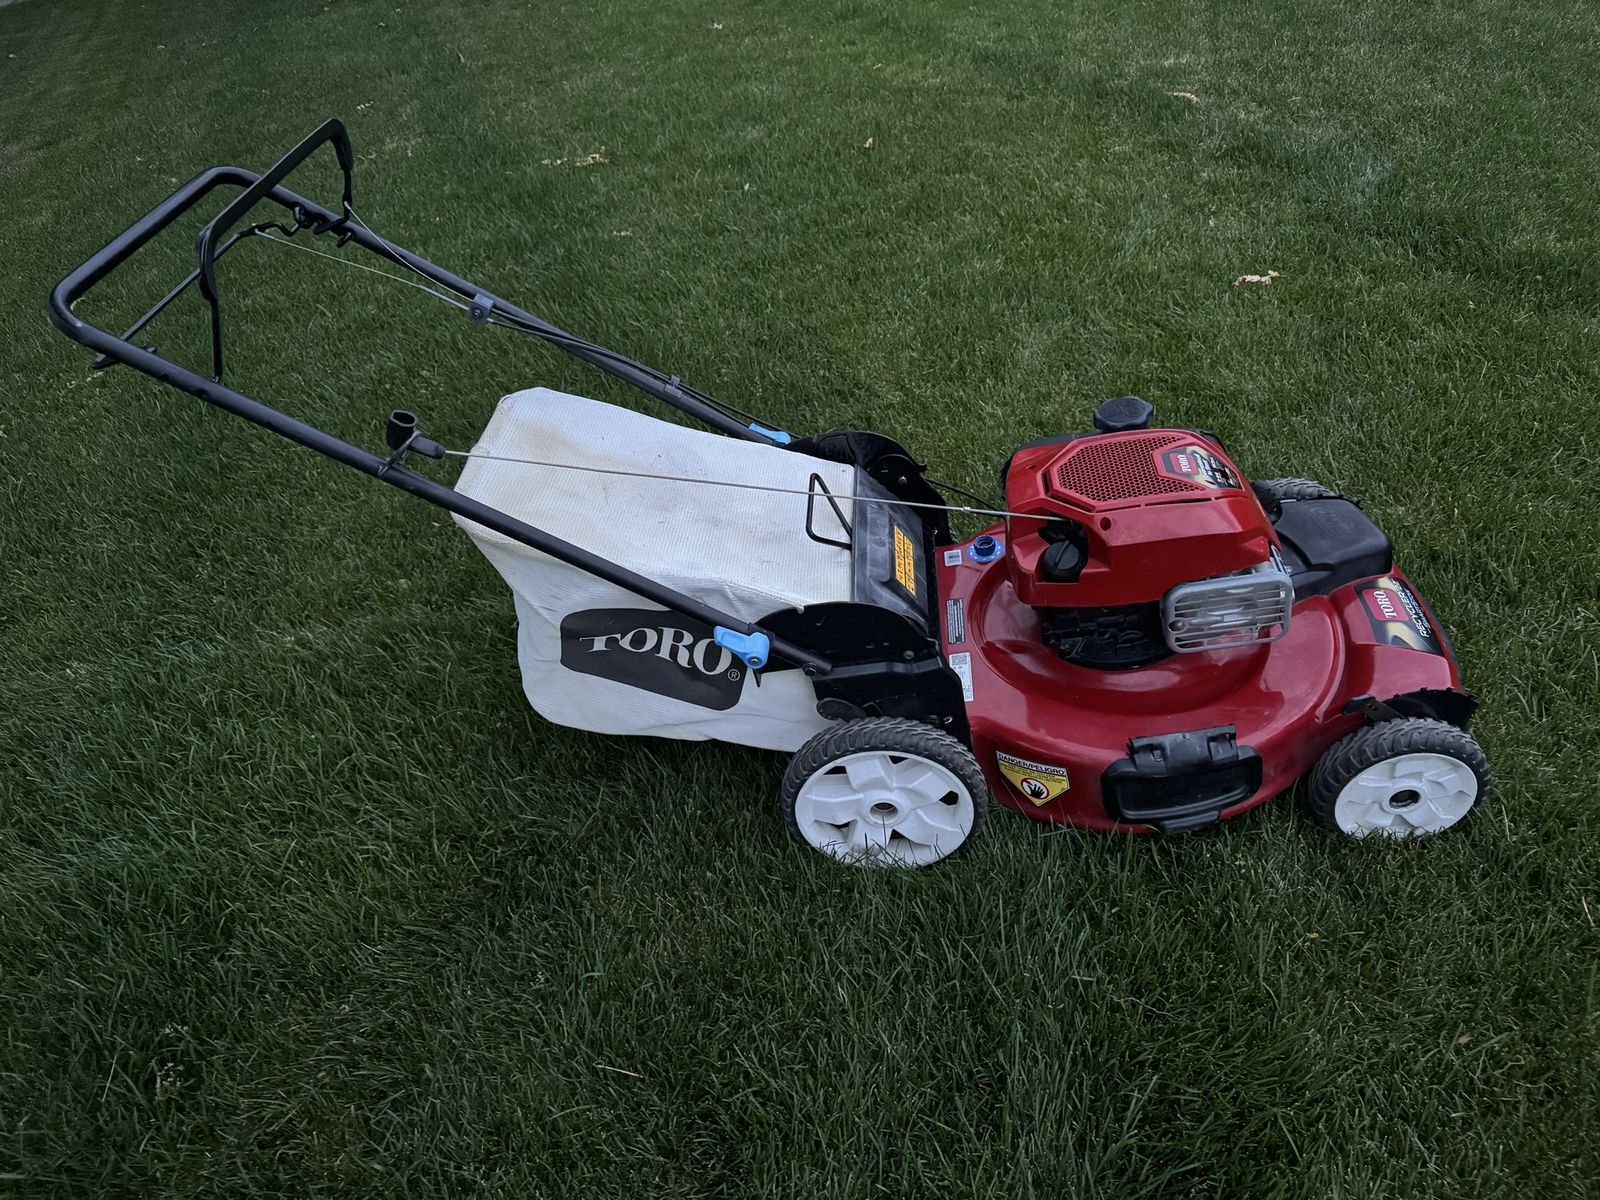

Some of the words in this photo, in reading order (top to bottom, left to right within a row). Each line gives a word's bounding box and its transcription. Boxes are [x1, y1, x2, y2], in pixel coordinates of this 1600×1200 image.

[1177, 454, 1191, 472] TORO
[1373, 590, 1398, 619] TORO
[1398, 591, 1430, 638] RECYCLER
[579, 626, 733, 676] TORO
[998, 754, 1066, 775] DANGER/PELIGRO
